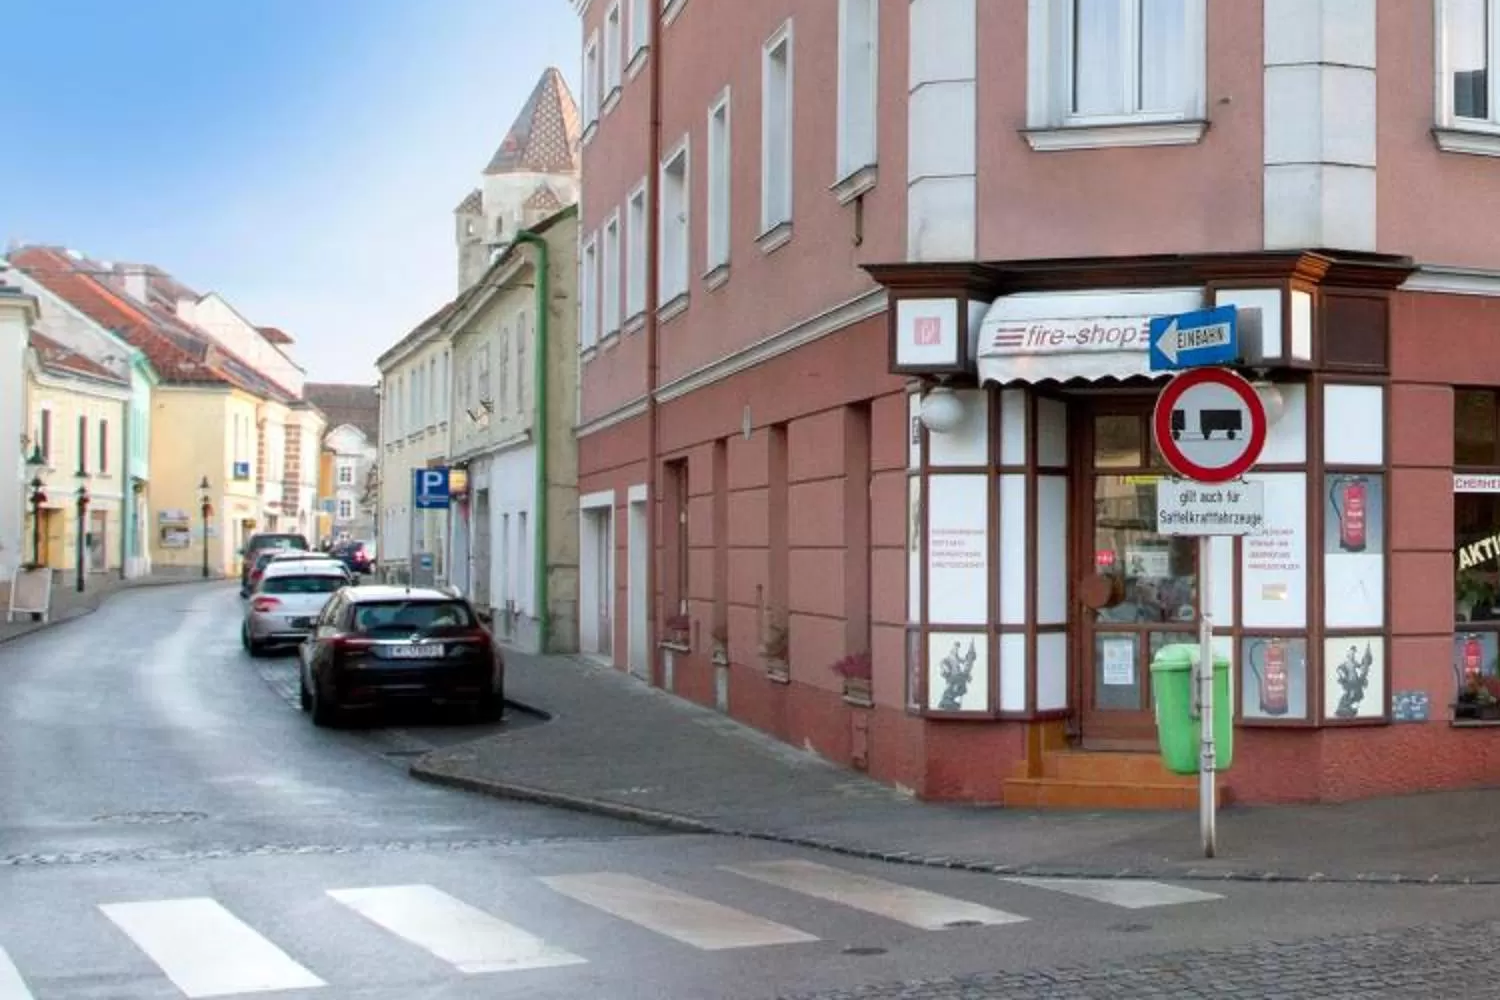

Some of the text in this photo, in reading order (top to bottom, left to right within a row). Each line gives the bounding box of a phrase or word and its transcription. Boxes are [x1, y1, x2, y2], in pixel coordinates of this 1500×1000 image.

[1026, 323, 1136, 347] fire-shop
[1177, 325, 1225, 349] EINBAHN
[423, 471, 443, 497] P
[1179, 489, 1241, 507] gilt auch für
